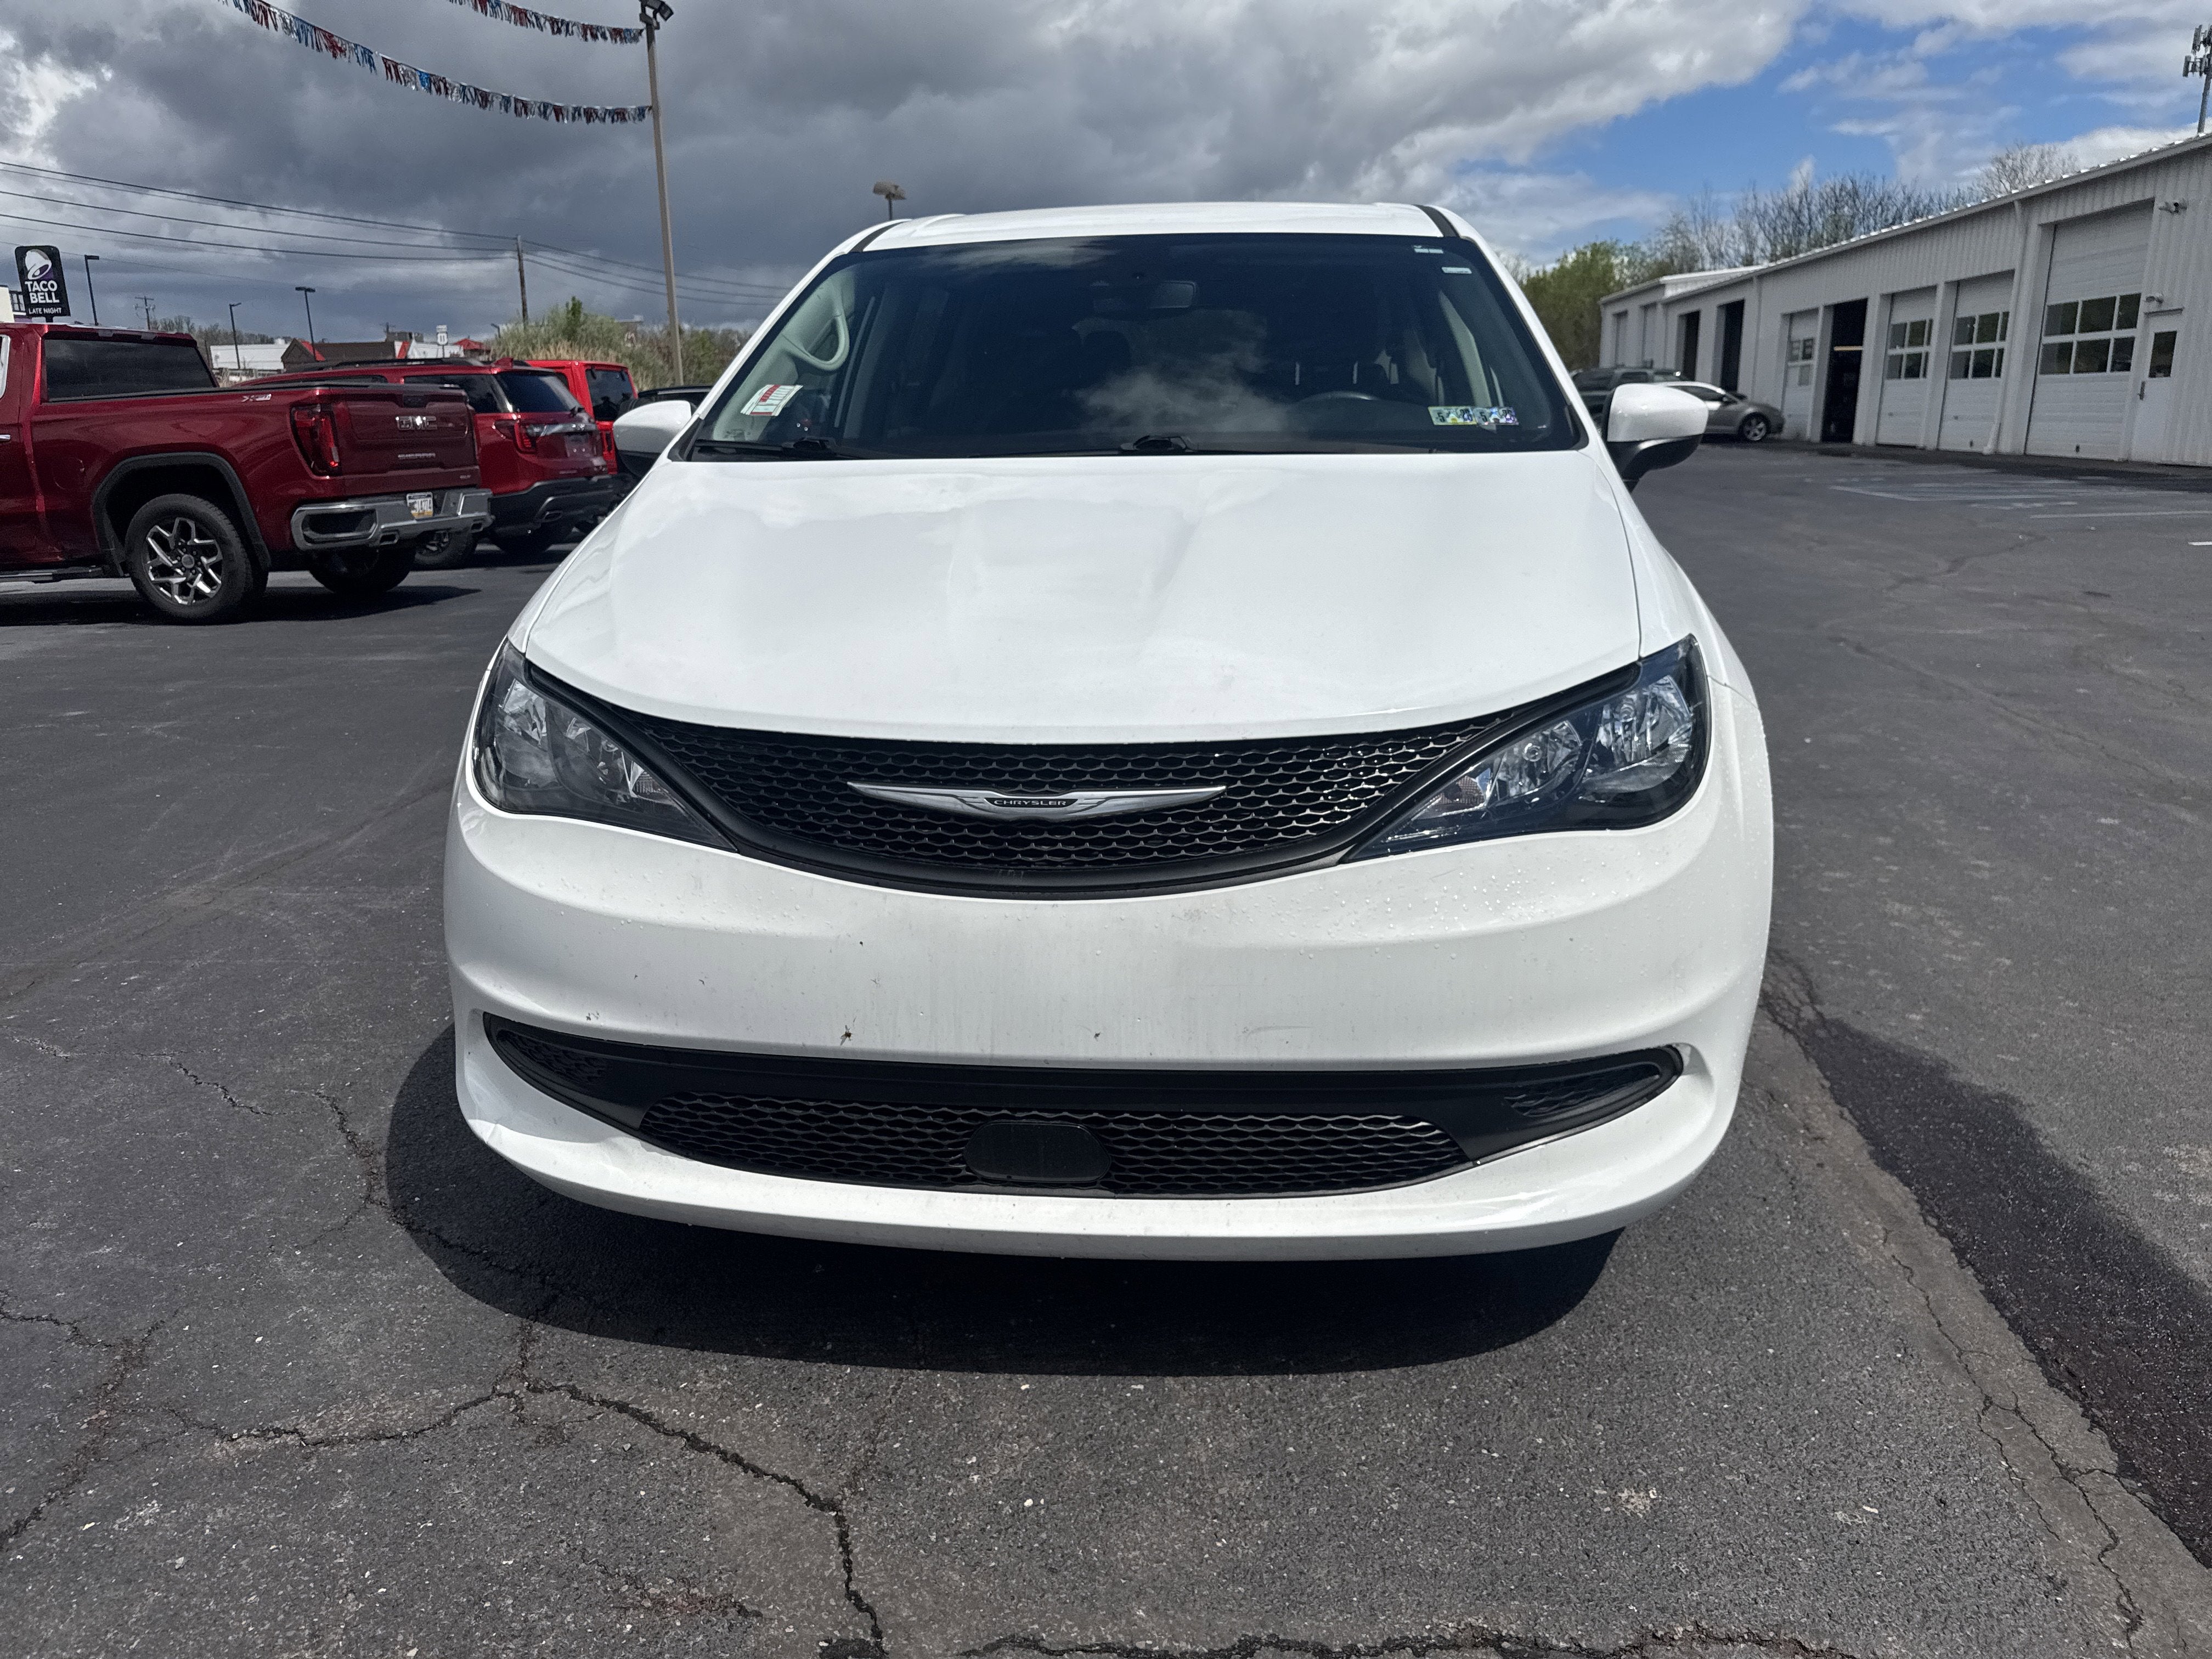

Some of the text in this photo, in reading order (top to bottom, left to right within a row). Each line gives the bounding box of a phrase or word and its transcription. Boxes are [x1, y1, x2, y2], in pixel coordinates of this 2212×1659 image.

[25, 280, 58, 292] TACO
[30, 292, 60, 303] BELL
[396, 415, 438, 431] GMC
